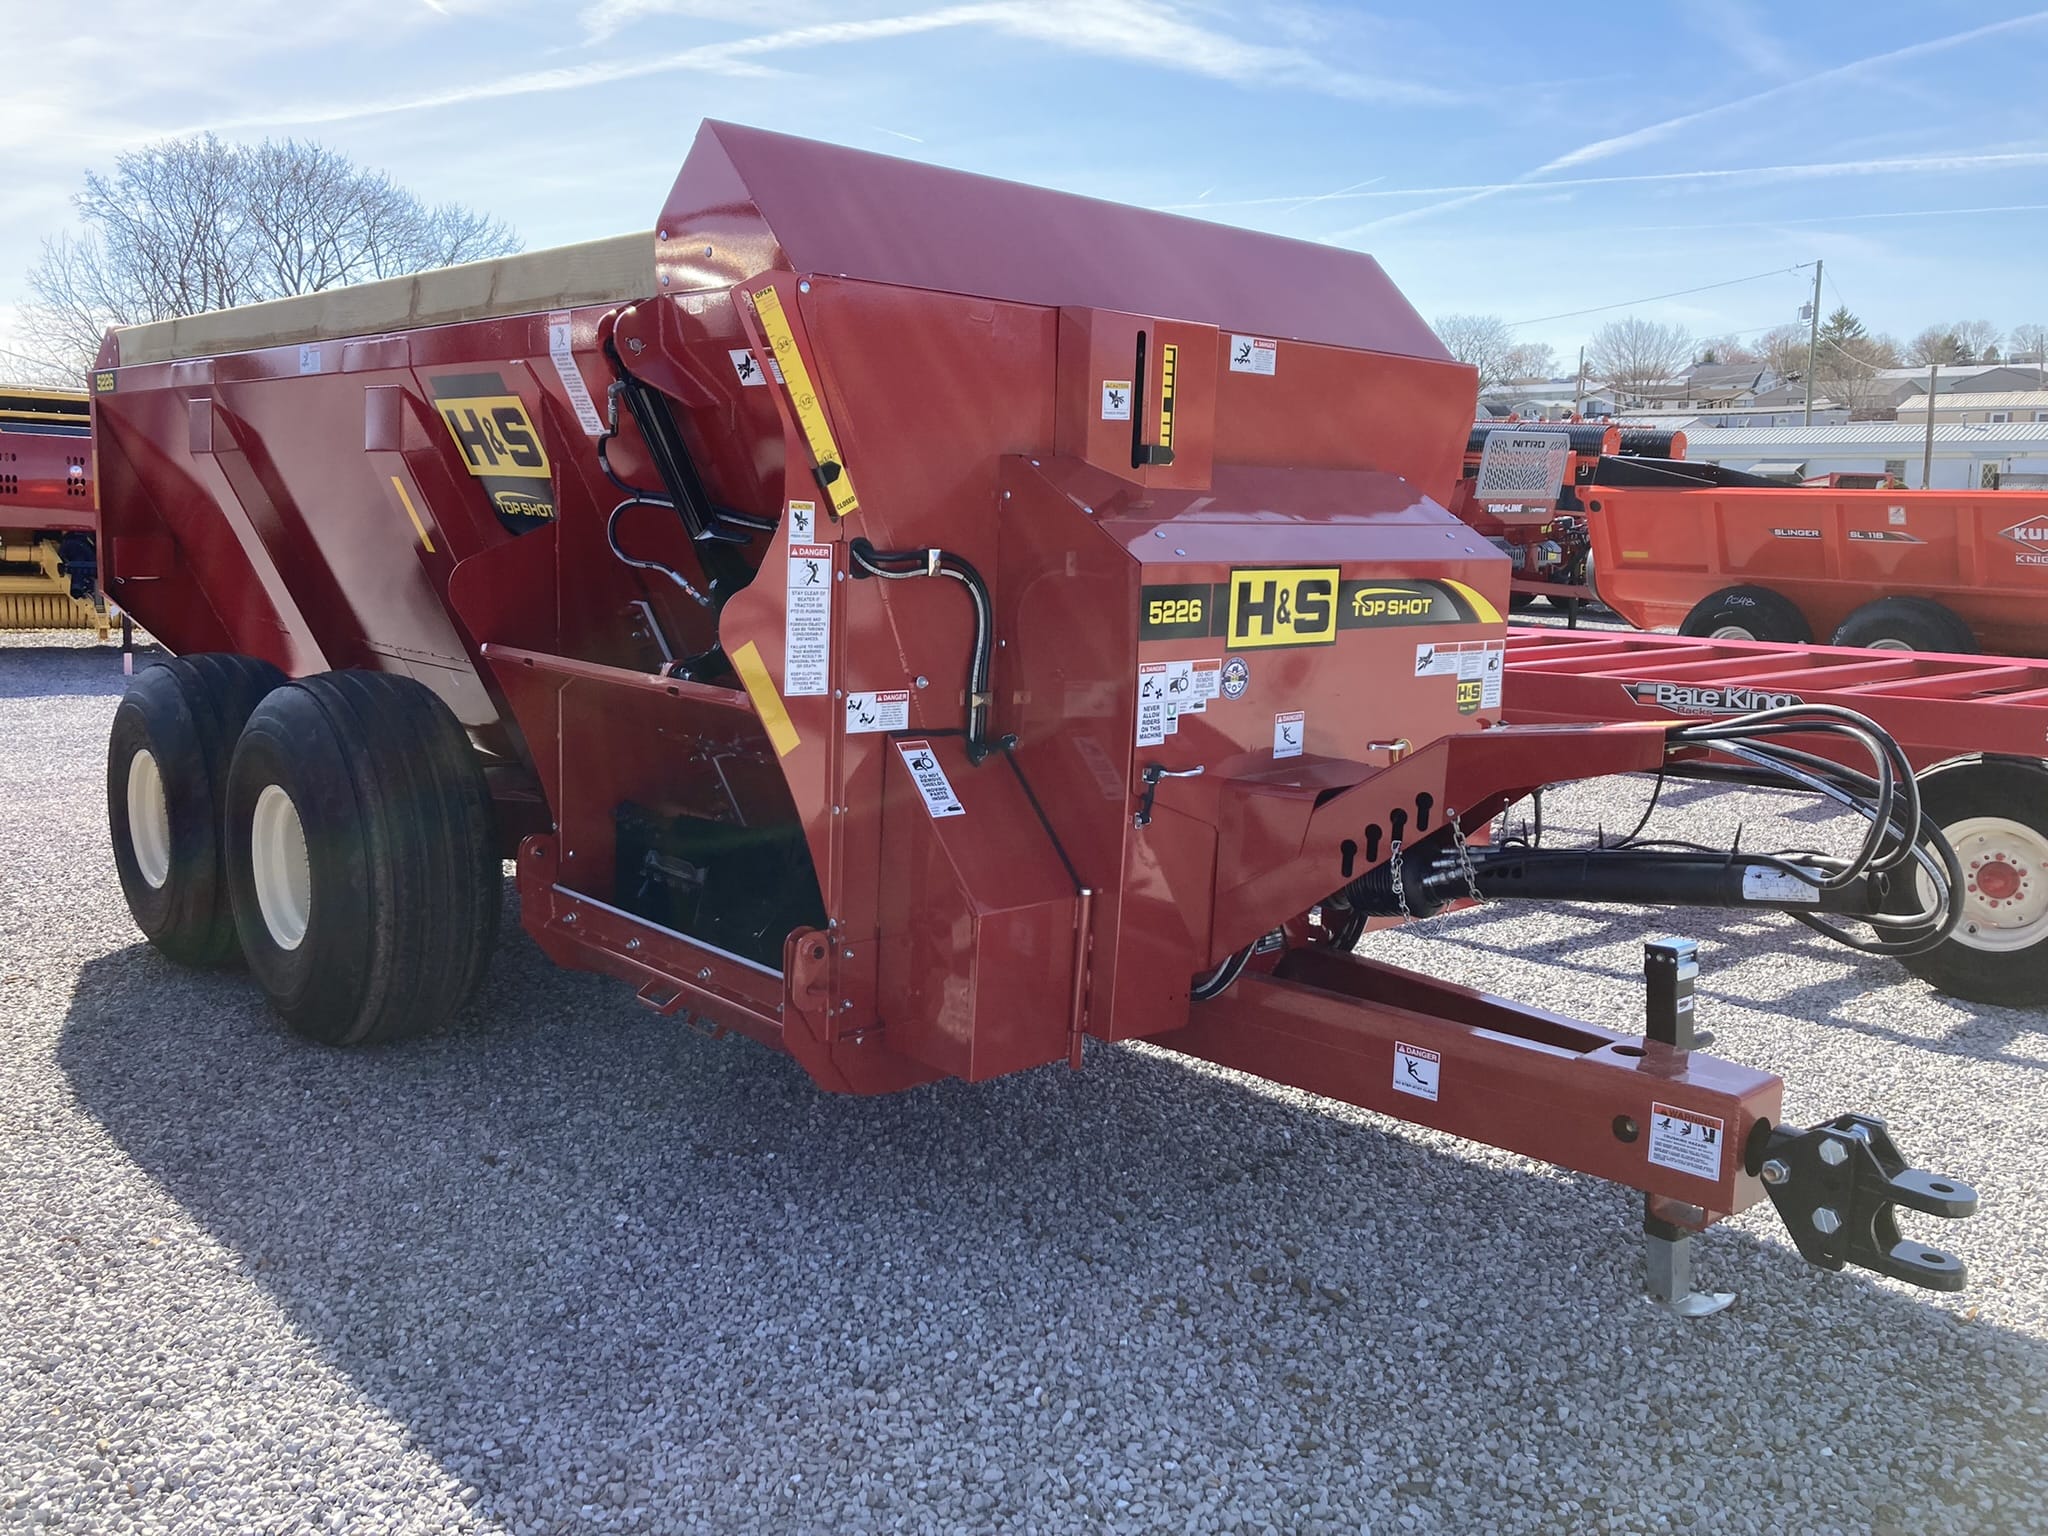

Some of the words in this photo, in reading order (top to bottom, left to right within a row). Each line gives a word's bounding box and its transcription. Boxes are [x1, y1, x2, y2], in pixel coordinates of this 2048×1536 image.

[755, 288, 772, 298] OPEN
[445, 408, 544, 467] H&S
[1513, 440, 1546, 448] NITRO
[496, 501, 521, 516] TOP
[524, 502, 553, 518] SHOT
[837, 496, 856, 510] CLOSED
[1774, 528, 1819, 537] SLINGER
[800, 548, 829, 557] DANGER
[1149, 600, 1202, 624] 5226
[1235, 579, 1332, 638] H&S
[1352, 599, 1386, 616] TOP
[1388, 599, 1432, 615] SHOT
[1458, 685, 1480, 700] H&S
[1656, 684, 1720, 706] Bale
[1725, 688, 1792, 711] King
[1676, 706, 1713, 716] Racks
[1406, 1047, 1438, 1062] DANGER
[1670, 1108, 1714, 1128] WARNING
